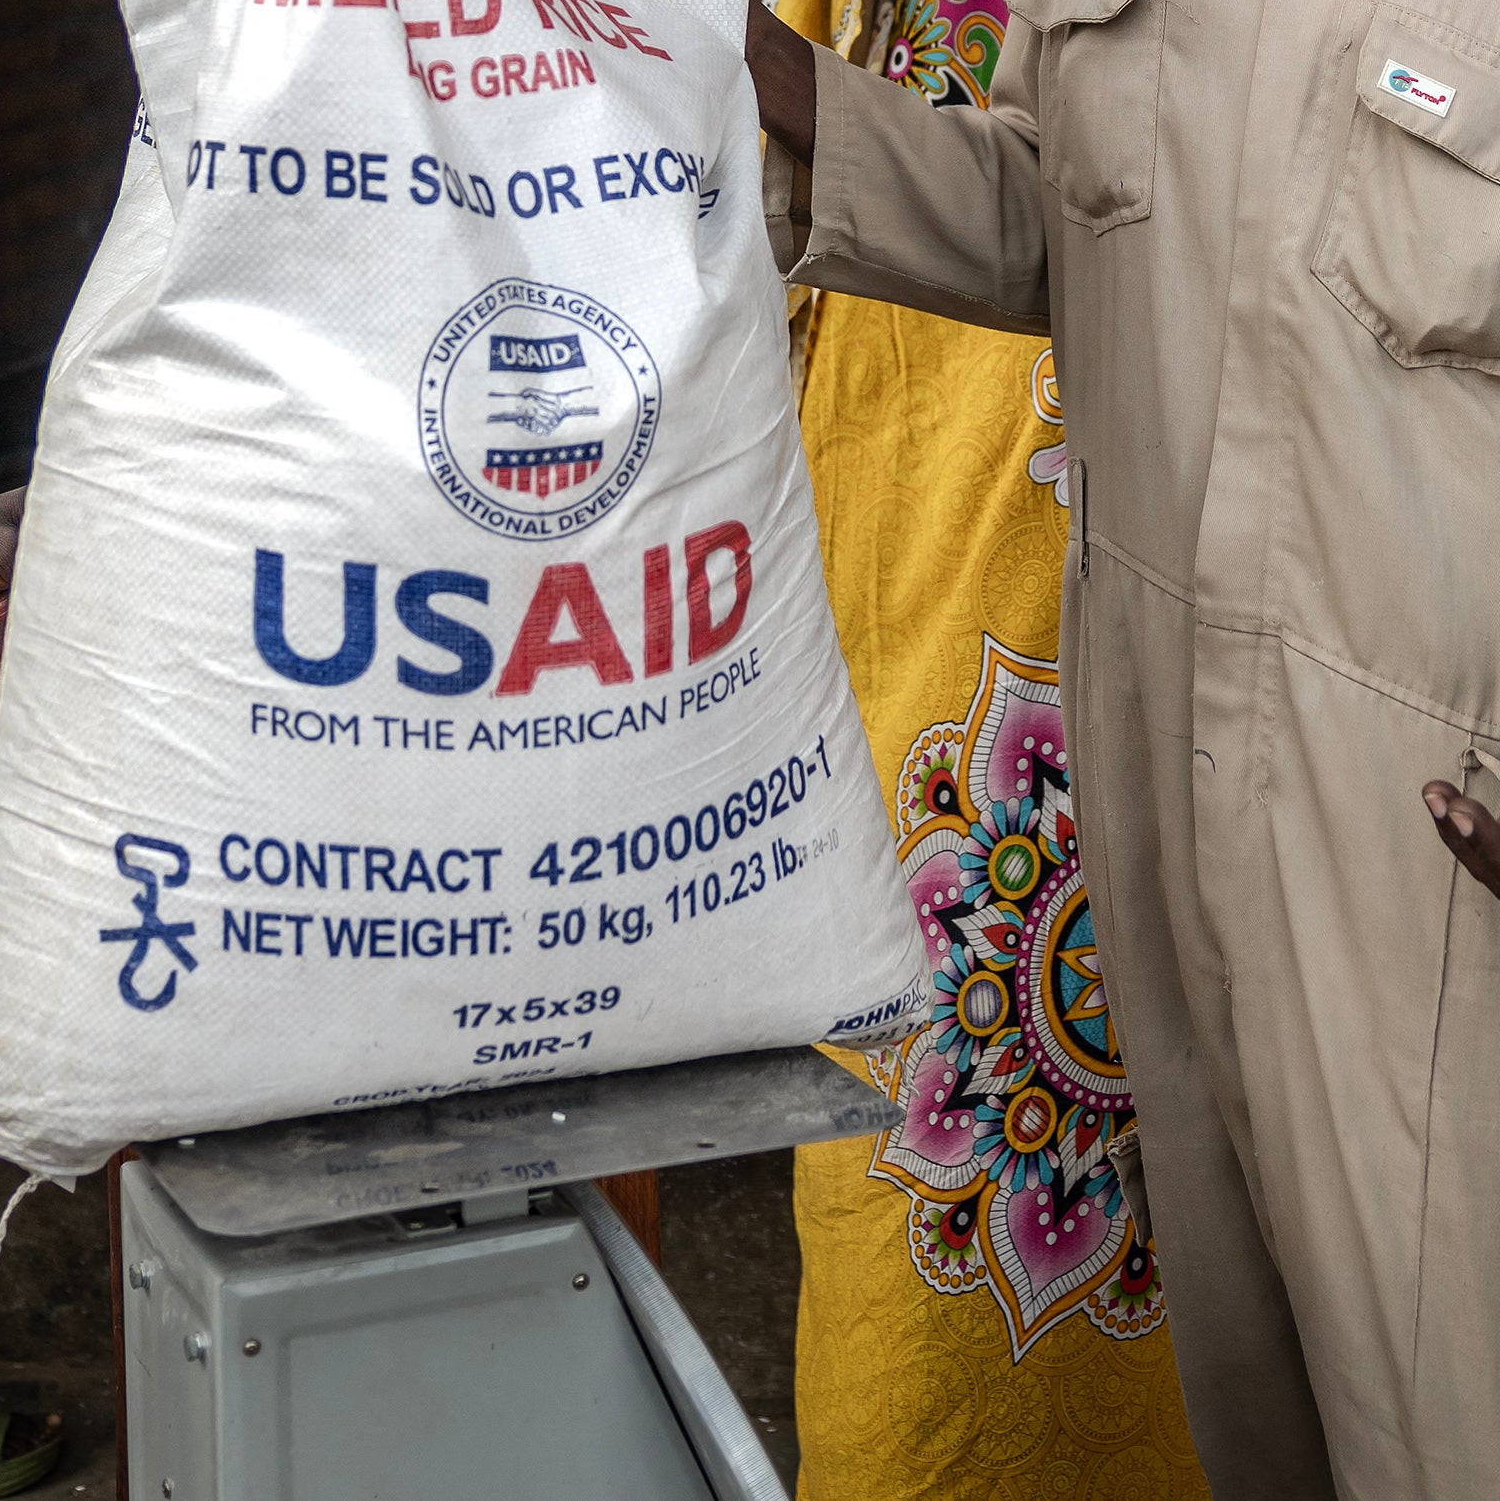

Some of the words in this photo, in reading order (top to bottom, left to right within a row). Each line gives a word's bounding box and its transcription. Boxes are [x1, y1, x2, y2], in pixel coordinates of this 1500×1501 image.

[471, 48, 596, 99] GRAIN
[238, 144, 303, 195] TO
[325, 149, 388, 202] BE
[409, 154, 496, 220] SOLD
[507, 164, 584, 220] OR
[433, 294, 497, 363] UNITED
[497, 284, 547, 305] STATES
[551, 294, 638, 351] AGENCY
[499, 341, 573, 367] USAID
[424, 408, 552, 534] INTERNATIONAL
[558, 393, 656, 532] DEVELOPMENT
[253, 519, 754, 699] USAID
[251, 703, 360, 747] FROM
[373, 715, 455, 750] THE
[467, 696, 668, 751] AMERICAN
[679, 647, 762, 719] PEOPLE
[219, 833, 502, 894] CONTRACT
[528, 734, 832, 888] 4210006920-1
[221, 911, 315, 958] NET
[326, 910, 513, 959] WEIGHT:
[536, 901, 585, 951] 50
[598, 890, 656, 950] kg,
[665, 851, 766, 927] 110.23
[771, 837, 804, 882] lb.
[472, 1030, 594, 1065] SMR-1
[332, 1088, 408, 1106] CROP
